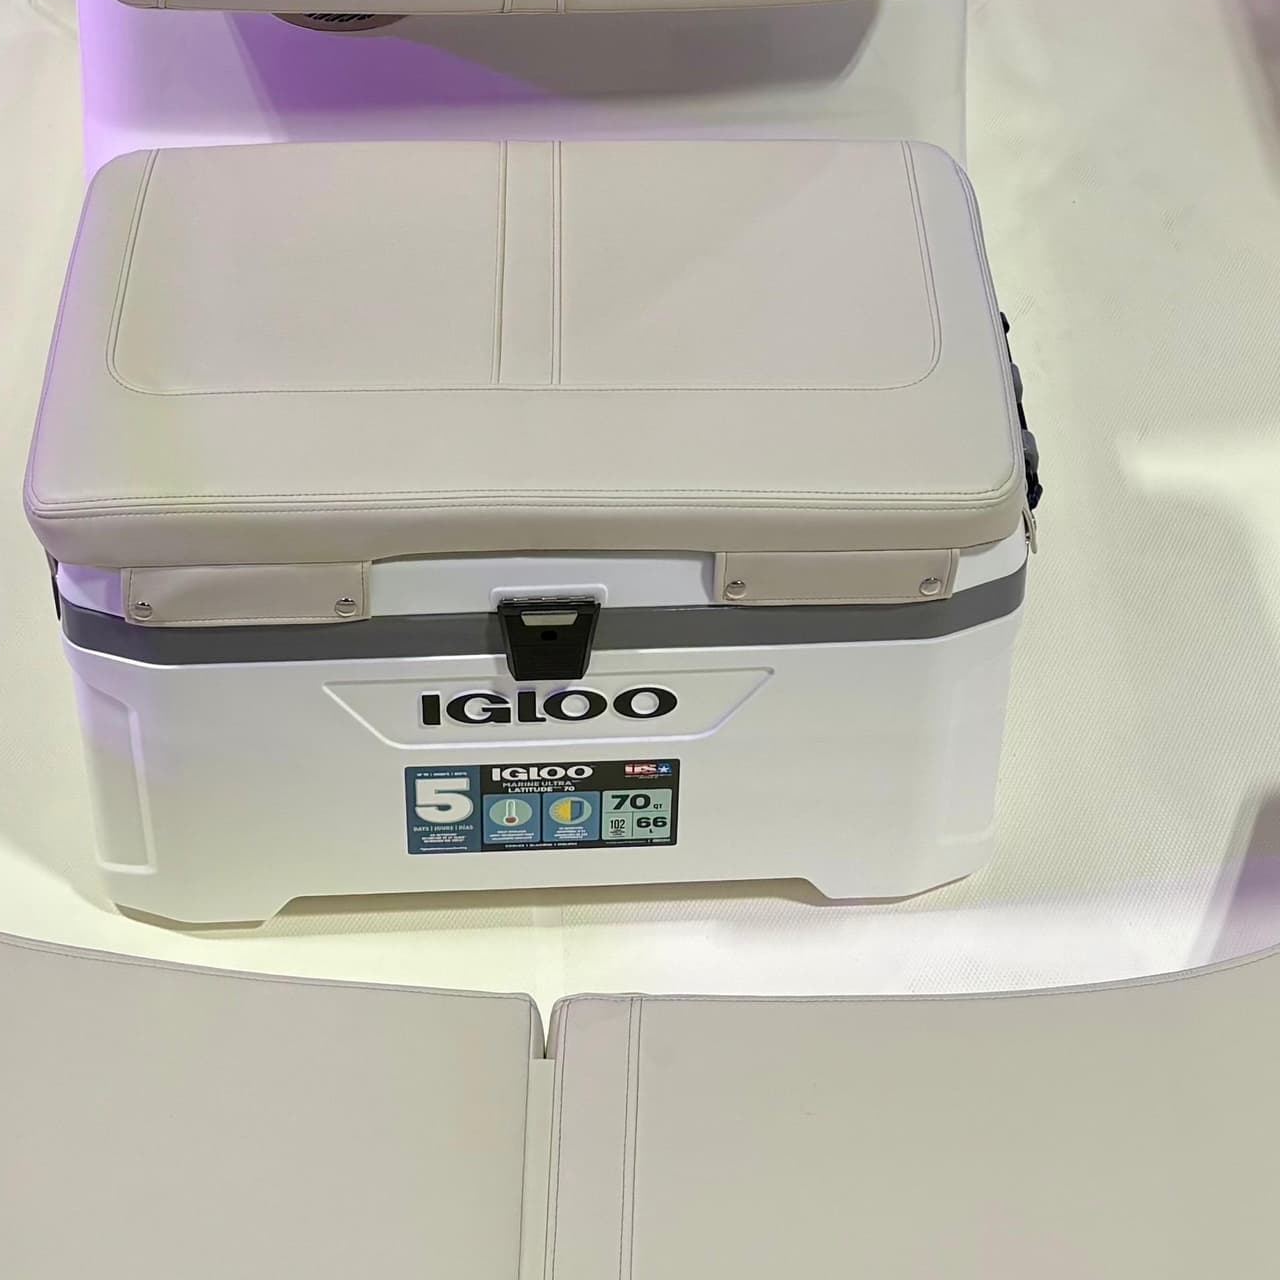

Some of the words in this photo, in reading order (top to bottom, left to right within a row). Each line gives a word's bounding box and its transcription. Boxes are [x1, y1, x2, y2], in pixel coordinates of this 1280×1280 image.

[421, 687, 677, 726] IGLOO
[492, 765, 594, 781] IGLOO
[415, 778, 474, 823] 5
[611, 793, 651, 810] 70
[610, 818, 626, 830] 102
[636, 816, 667, 828] 66
